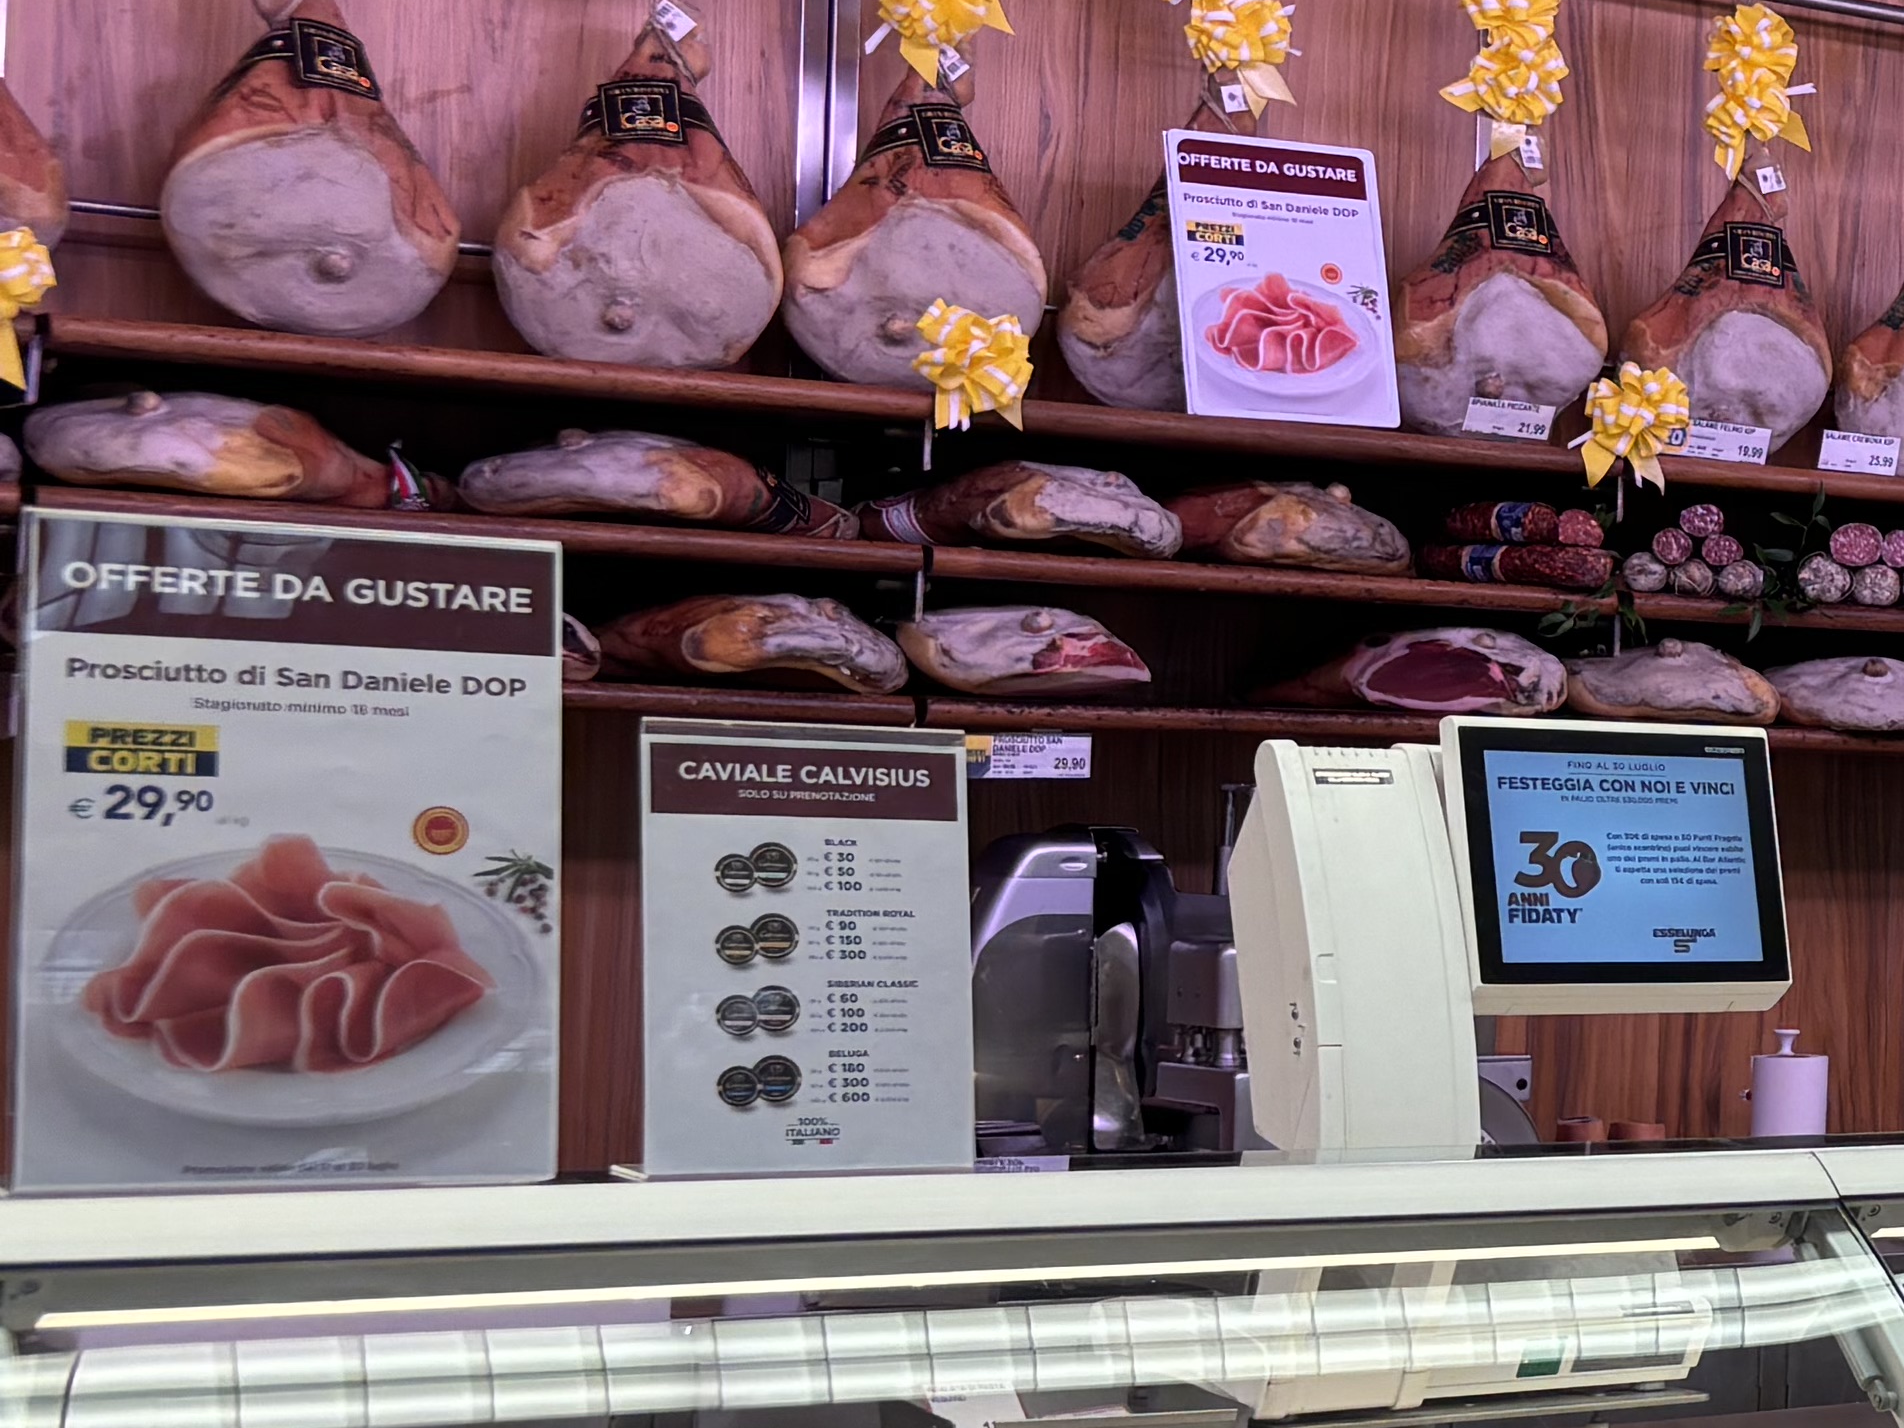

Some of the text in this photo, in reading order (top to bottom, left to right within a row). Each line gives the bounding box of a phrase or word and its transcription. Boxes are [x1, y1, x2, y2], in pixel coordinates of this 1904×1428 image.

[1178, 152, 1358, 182] OFFERTE DA GUSTARE
[1183, 193, 1360, 218] Prosciutto di San Daniele DOP
[1195, 232, 1237, 245] CORTI
[1191, 246, 1244, 265] € 29,90
[63, 561, 533, 614] OFFERTE DA GUSTARE
[66, 657, 527, 698] Prosciutto di San Daniele DOP
[194, 697, 281, 713] Stagionato
[287, 703, 347, 716] minimo
[372, 706, 410, 717] mesi
[89, 726, 196, 748] PREZZI
[87, 749, 196, 774] CORTI
[1567, 760, 1592, 770] FINO
[1597, 761, 1609, 770] AL
[1628, 763, 1666, 772] LUGLIO
[679, 761, 931, 788] CAVIALE CALVISIUS
[1497, 776, 1735, 796] FESTEGGIA CON NOI E VINCI
[738, 789, 876, 802] SOLO SU PRENOTAZIONE
[68, 797, 95, 820] €
[102, 784, 214, 827] 29,90
[824, 852, 855, 862] € 30
[1514, 830, 1602, 898] 30
[824, 867, 855, 876] € 50
[824, 881, 862, 891] € 100
[1507, 892, 1549, 907] ANNI
[826, 909, 916, 918] TRADITION ROYAL
[1507, 907, 1579, 924] FIDATY
[1653, 928, 1716, 938] ESSELUNGA
[827, 980, 920, 988] SIBERIAN CLASSIC
[829, 1049, 870, 1058] BELUGA
[828, 1063, 837, 1073] €
[828, 1078, 870, 1088] € 300
[828, 1092, 870, 1102] € 600
[785, 1127, 840, 1137] ITALIANO
